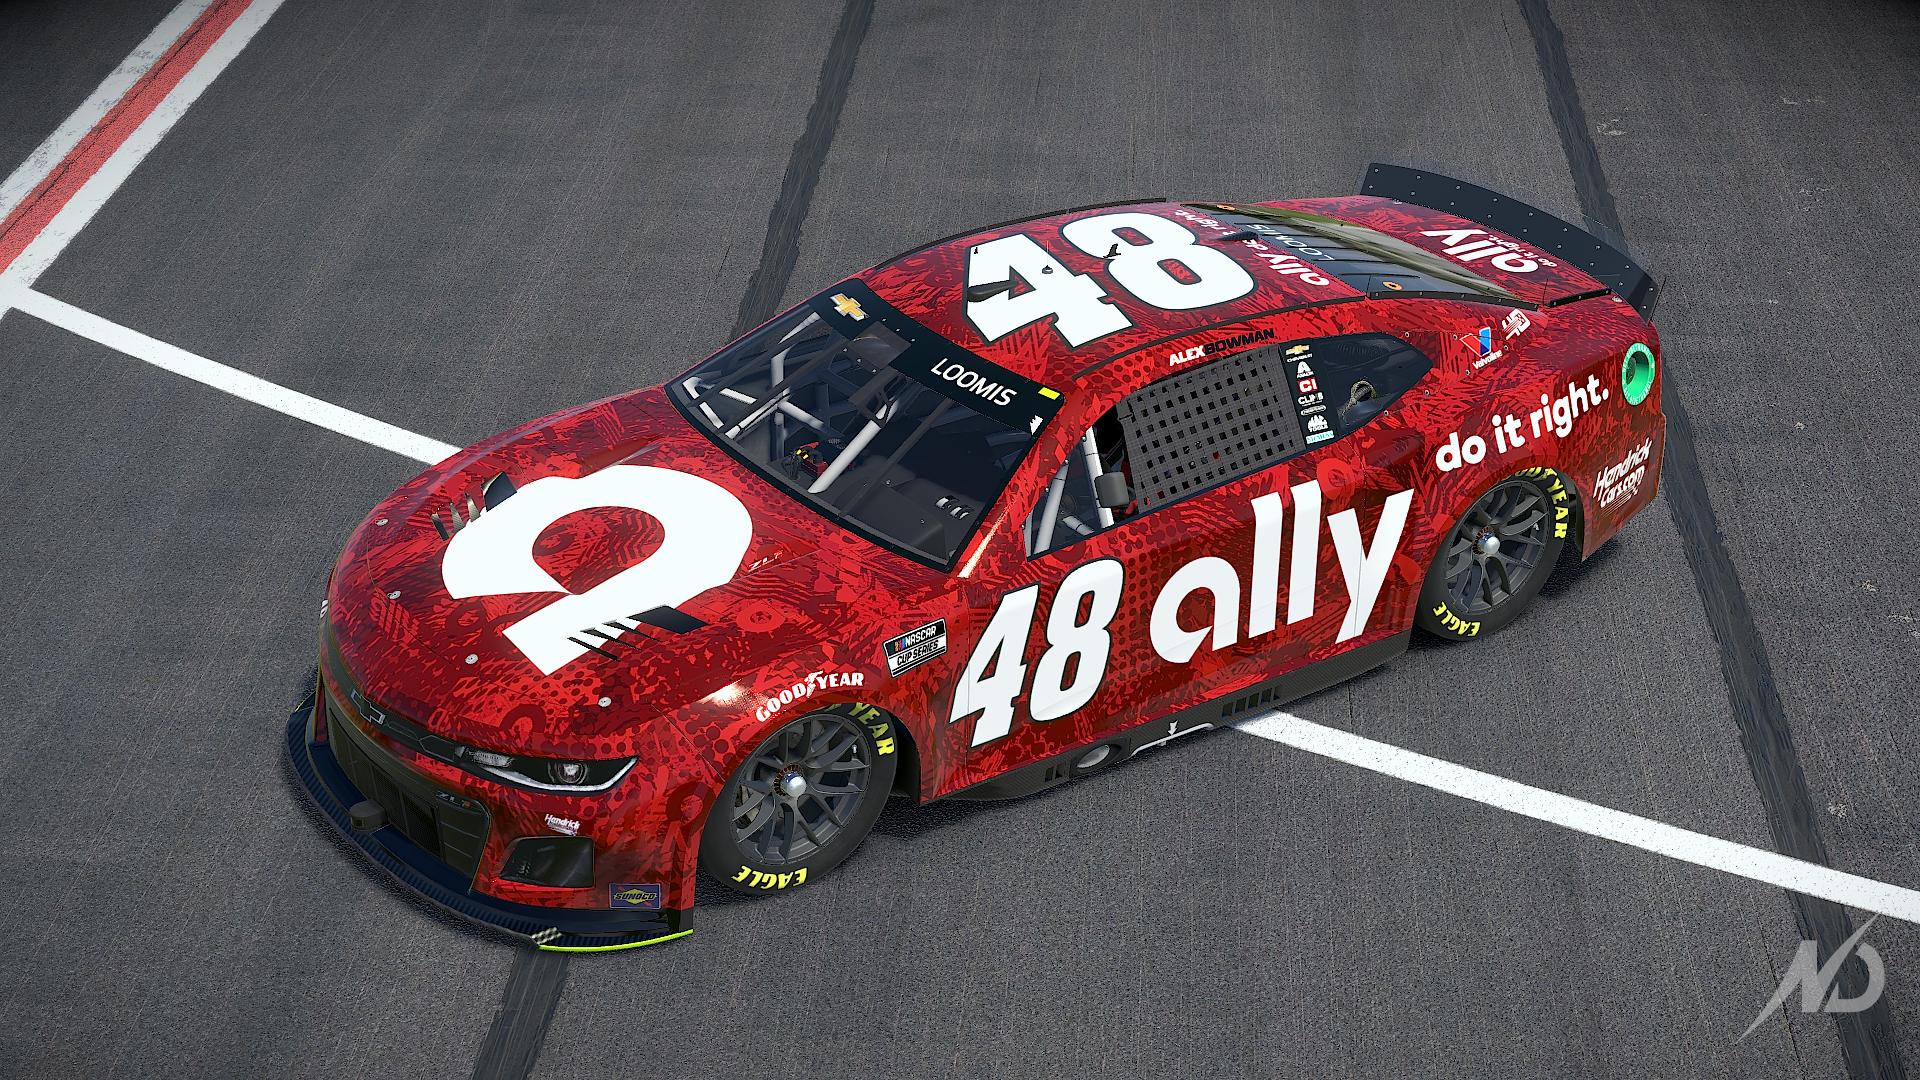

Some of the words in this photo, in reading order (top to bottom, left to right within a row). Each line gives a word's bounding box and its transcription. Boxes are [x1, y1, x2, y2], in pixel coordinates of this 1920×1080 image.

[1255, 253, 1330, 286] ally
[1419, 229, 1539, 273] ally
[966, 212, 1256, 348] 48
[1472, 349, 1503, 370] Valvoline
[931, 357, 1018, 406] LOOMIS
[1435, 432, 1487, 472] do
[1492, 415, 1525, 455] it
[1530, 374, 1610, 439] right.
[1593, 437, 1653, 502] Hendrick
[1149, 479, 1415, 664] ally
[905, 625, 937, 648] NASCAR
[1432, 600, 1482, 638] EAGLE
[897, 651, 913, 666] CUP
[913, 640, 939, 660] SERIES
[949, 556, 1126, 748] 48
[755, 670, 864, 723] GOODYEAR
[544, 813, 580, 830] Hendrick
[613, 892, 658, 901] SUNOCO
[731, 864, 809, 891] EAGLE
